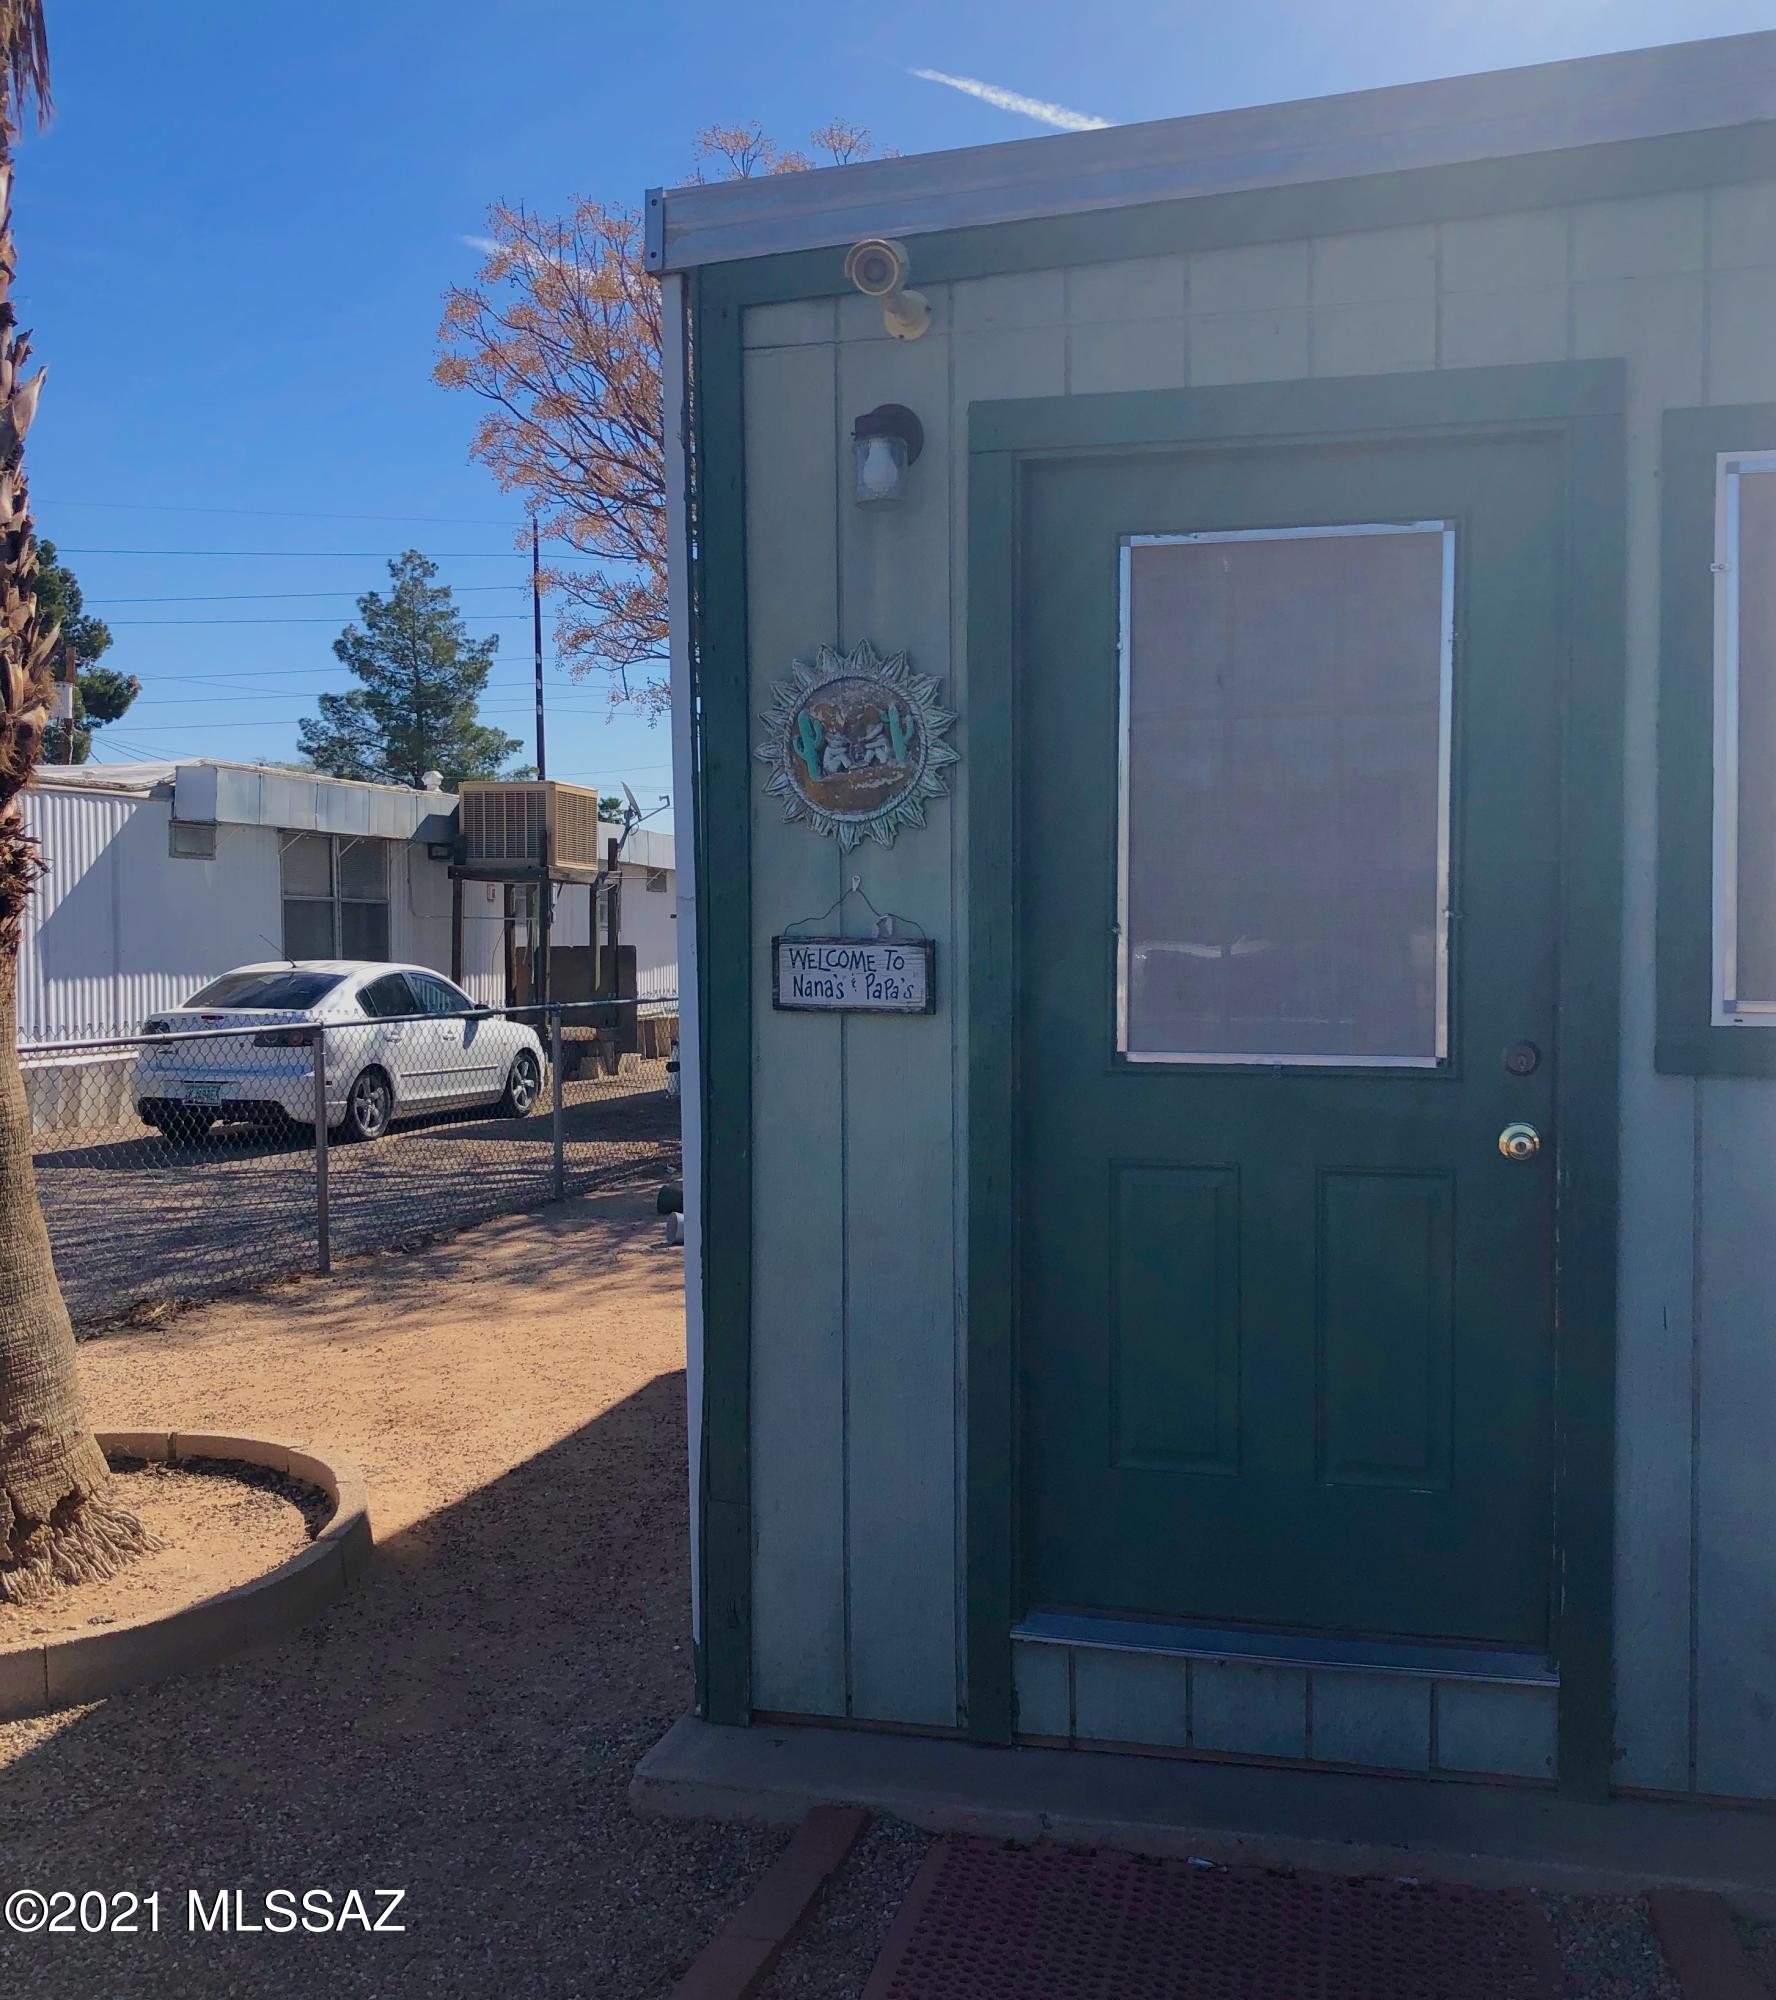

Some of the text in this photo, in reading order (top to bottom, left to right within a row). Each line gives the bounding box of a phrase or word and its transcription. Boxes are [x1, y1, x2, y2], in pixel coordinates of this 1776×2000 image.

[789, 946, 905, 972] WELCOME TO
[793, 974, 845, 1000] Nana's
